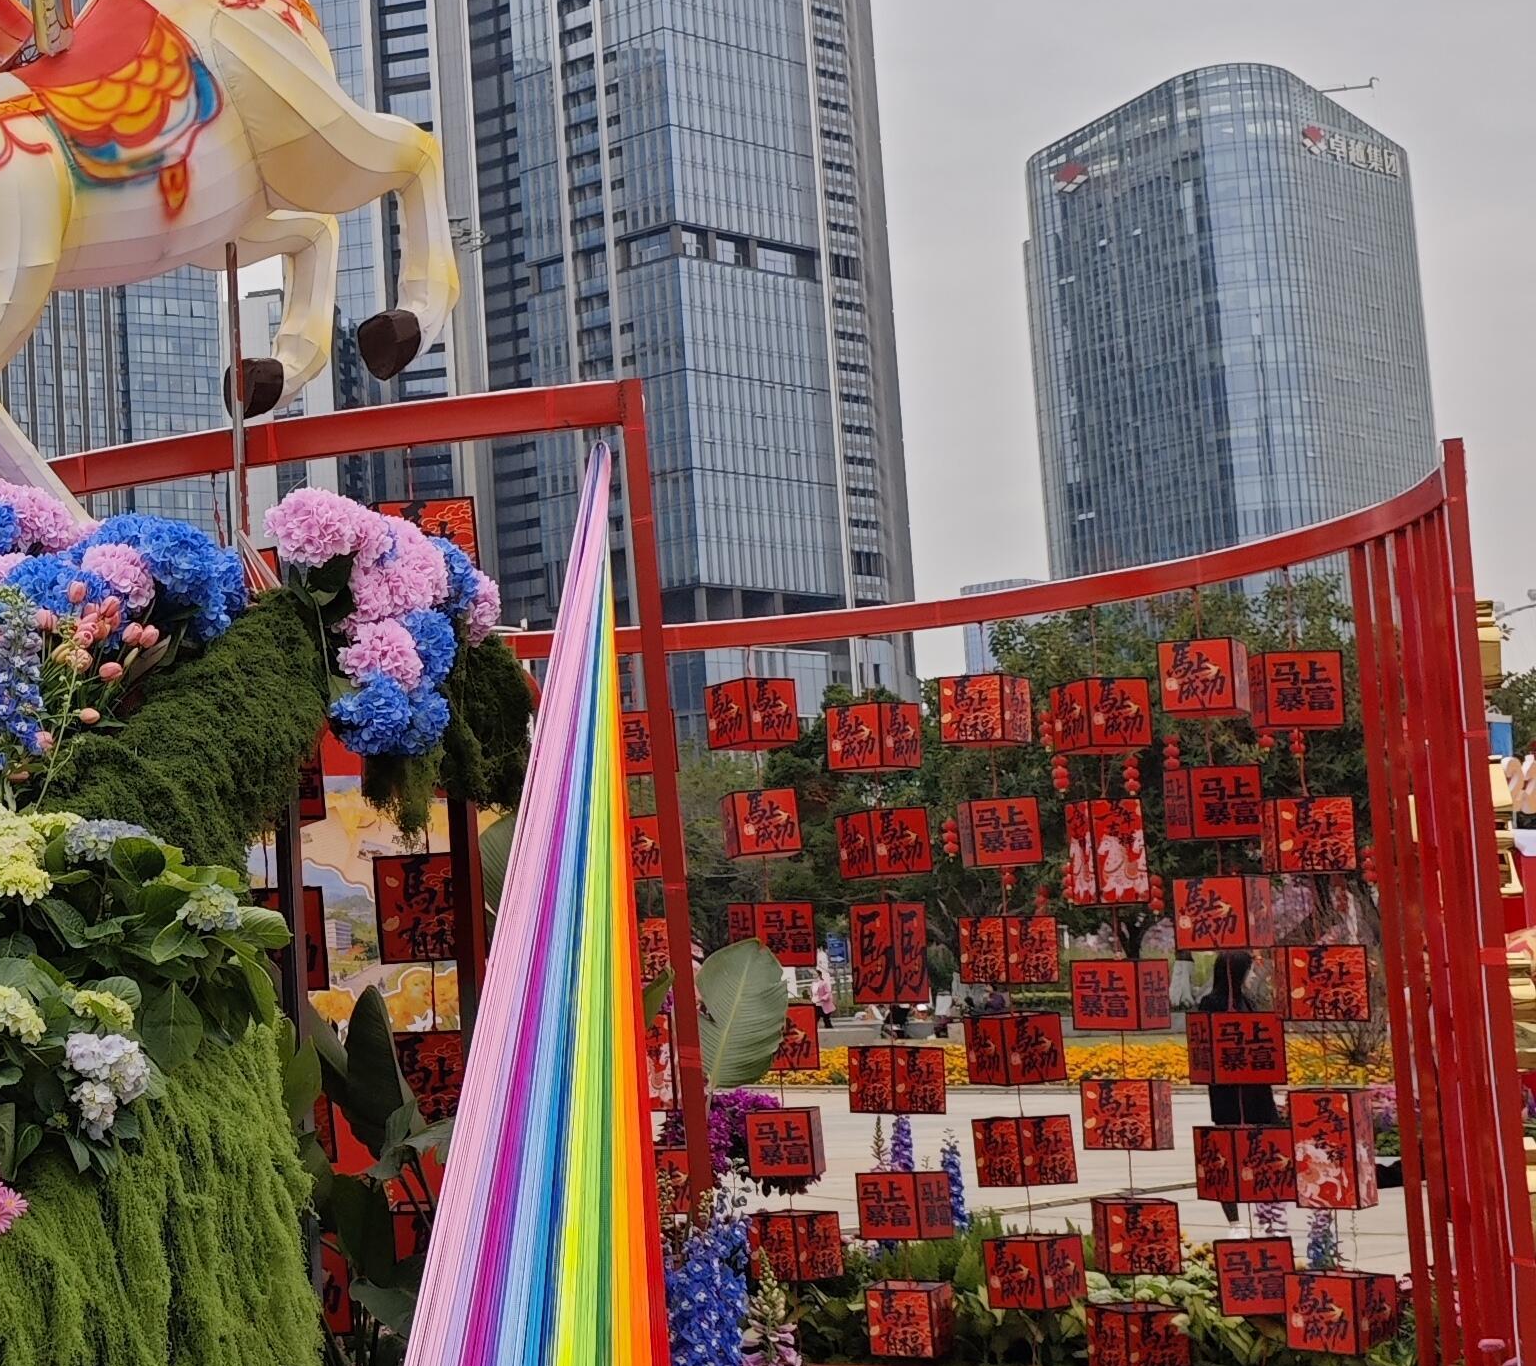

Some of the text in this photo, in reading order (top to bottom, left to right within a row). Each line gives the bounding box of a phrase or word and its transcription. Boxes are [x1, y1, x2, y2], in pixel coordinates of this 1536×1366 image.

[1329, 133, 1400, 178] 卓越集团
[1168, 643, 1211, 676] 馬上
[1273, 661, 1331, 684] 马上
[755, 679, 781, 713] 馬上
[951, 677, 991, 712] 馬上
[1097, 680, 1131, 713] 馬上
[1179, 671, 1226, 708] 成功
[1278, 686, 1337, 711] 暴富
[623, 719, 649, 740] 马
[764, 712, 793, 741] 成功
[834, 706, 863, 739] 馬上
[887, 704, 910, 737] 馬上
[953, 714, 995, 740] 有福
[1106, 712, 1144, 745] 成功
[626, 741, 651, 762] 暴
[842, 736, 876, 769] 成功
[1200, 776, 1254, 800] 马上
[746, 793, 781, 826] 馬上
[976, 806, 1028, 830] 马上
[1206, 801, 1261, 826] 暴富
[1292, 798, 1342, 837] 馬上
[756, 823, 795, 851] 成功
[878, 811, 909, 845] 馬上
[984, 828, 1033, 853] 暴富
[889, 840, 923, 873] 成功
[1294, 840, 1349, 871] 有福
[1182, 878, 1222, 916] 馬上
[766, 909, 808, 932] 马上
[1017, 916, 1050, 951] 馬上
[1193, 914, 1237, 947] 成功
[1305, 945, 1355, 987] 馬上
[1078, 970, 1126, 994] 马上
[1081, 994, 1129, 1018] 暴富
[1303, 989, 1359, 1020] 有福
[1014, 1015, 1045, 1053] 馬上
[1219, 1021, 1273, 1045] 马上
[1024, 1047, 1059, 1083] 成功
[1222, 1047, 1277, 1072] 暴富
[1094, 1081, 1143, 1117] 馬上
[756, 1121, 806, 1143] 马上
[1098, 1119, 1146, 1148] 有福
[1243, 1127, 1281, 1165] 馬上
[761, 1143, 809, 1166] 暴富
[862, 1181, 906, 1204] 马上
[868, 1204, 912, 1227] 暴富
[1123, 1204, 1170, 1244] 馬上
[1123, 1244, 1175, 1275] 有福
[1225, 1248, 1284, 1273] 马上
[1231, 1274, 1284, 1302] 暴富
[1294, 1275, 1336, 1314] 馬上
[1304, 1313, 1348, 1351] 成功
